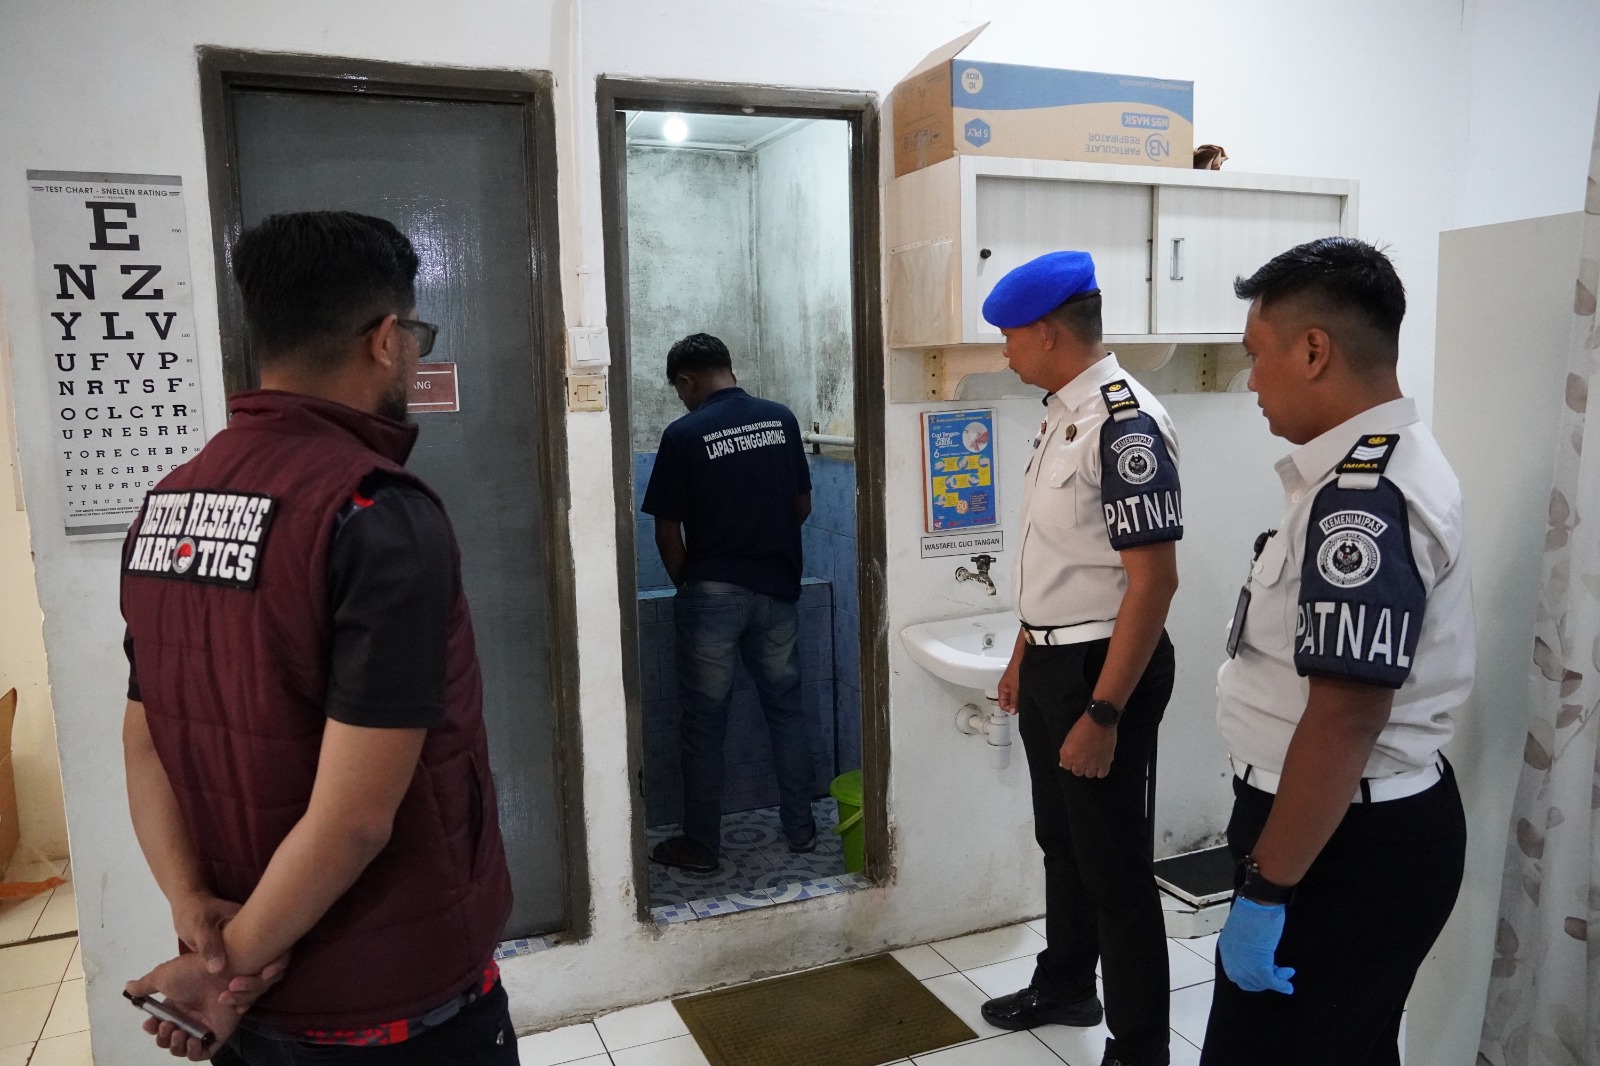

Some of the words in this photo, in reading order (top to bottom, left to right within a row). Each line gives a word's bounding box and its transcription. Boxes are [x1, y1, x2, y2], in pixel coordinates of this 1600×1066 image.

[1124, 114, 1150, 126] MASK
[1088, 134, 1140, 144] RESPIRATOR
[1084, 144, 1140, 156] PARTICULATE
[102, 188, 136, 196] SNELLEN
[138, 189, 168, 197] RATING
[85, 201, 140, 251] E
[702, 431, 724, 442] WARGA
[706, 438, 734, 460] LAPAS
[734, 430, 786, 452] TENGGARONG
[184, 492, 271, 542] RESERSE
[1104, 490, 1183, 539] PATNAL
[1324, 514, 1381, 532] KEMENIMIPAS
[924, 542, 957, 550] WASTAFEL
[974, 538, 1000, 546] TANGAN
[1296, 602, 1410, 668] PATNAL
